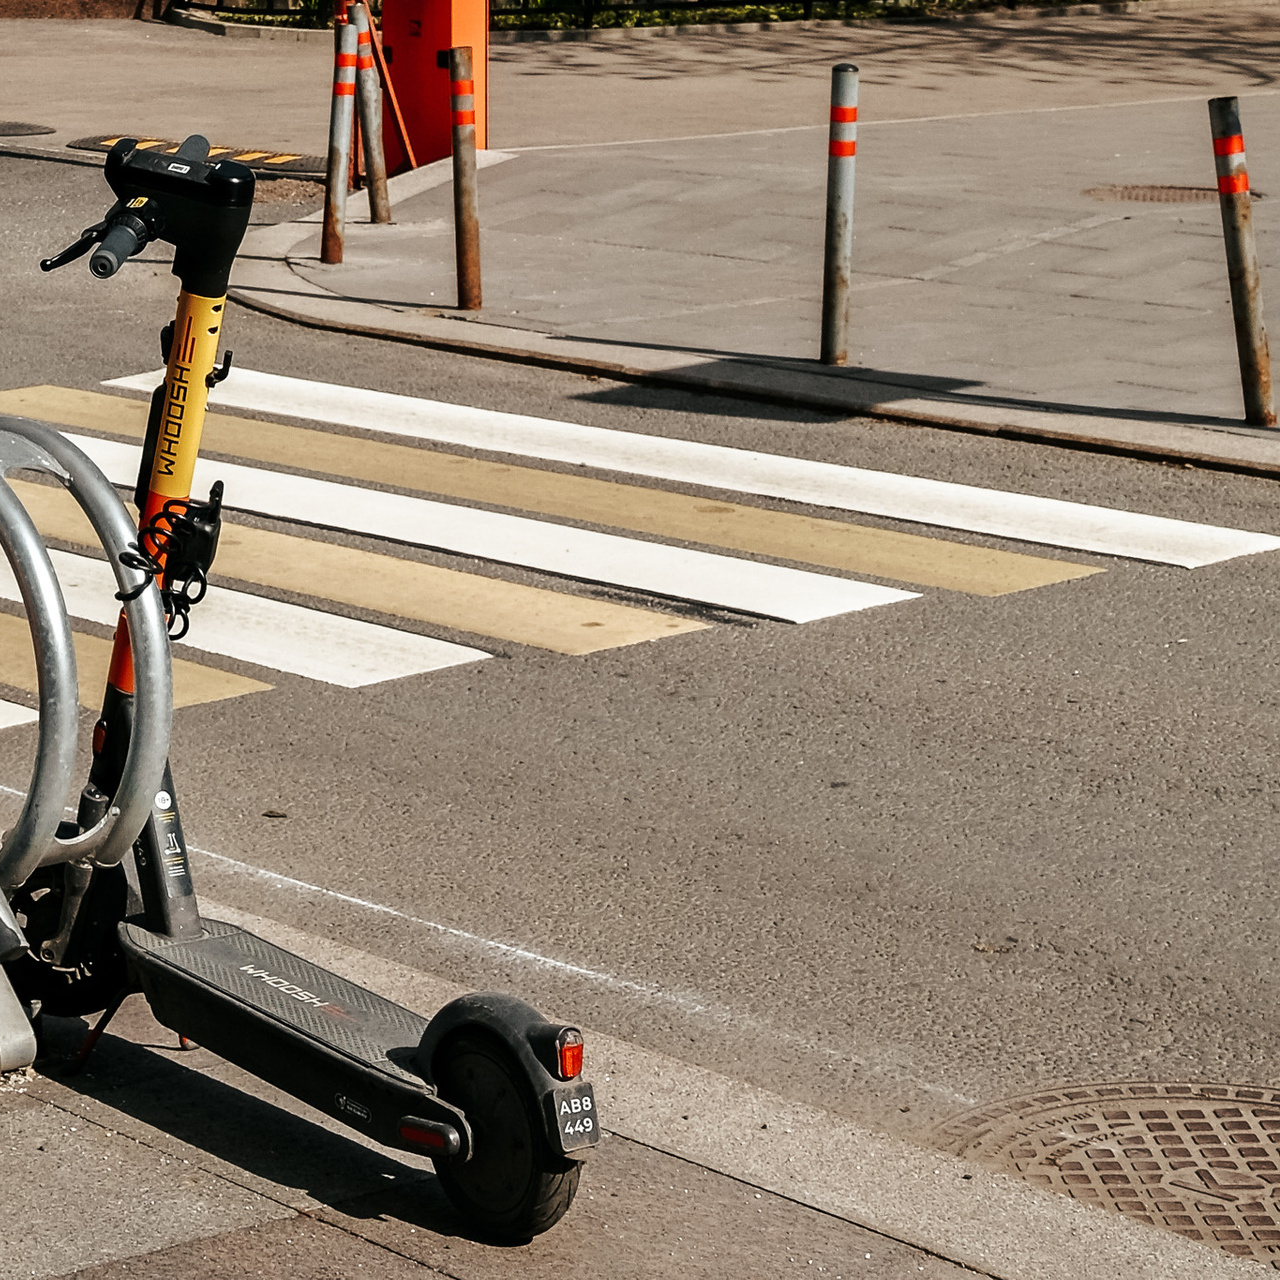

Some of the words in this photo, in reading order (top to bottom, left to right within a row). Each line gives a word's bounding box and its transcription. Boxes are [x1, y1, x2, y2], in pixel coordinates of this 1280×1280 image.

[157, 365, 191, 476] WHOOSH
[239, 965, 329, 1007] WHOOSH
[560, 1096, 592, 1116] AB8
[564, 1117, 593, 1135] 449
